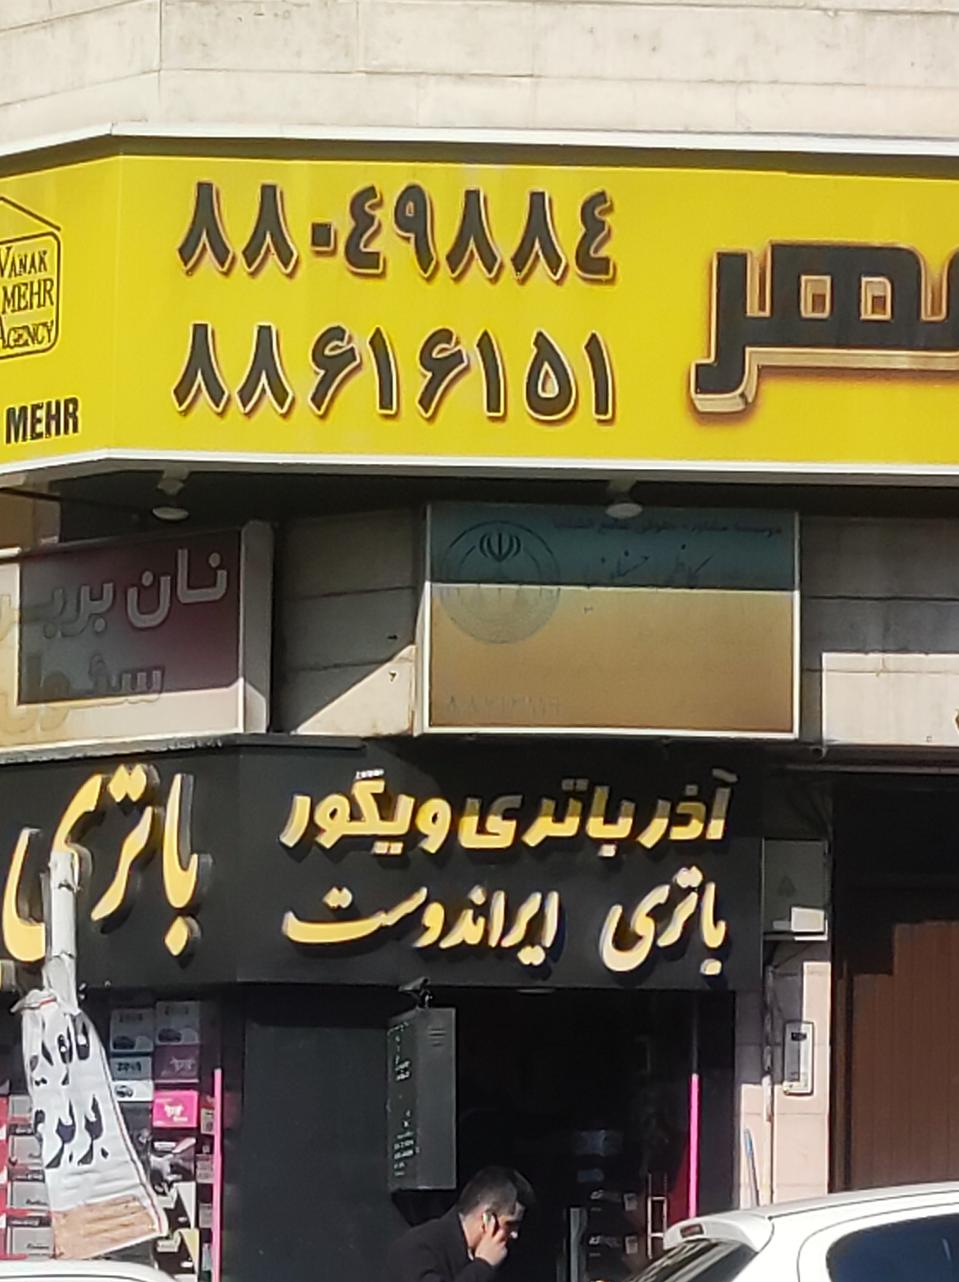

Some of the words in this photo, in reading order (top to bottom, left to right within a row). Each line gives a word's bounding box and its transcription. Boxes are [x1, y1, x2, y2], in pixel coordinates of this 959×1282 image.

[1, 277, 55, 316] MEHR
[690, 240, 959, 413] هر
[172, 322, 616, 424] ۸۸۶۱۶۱۵۱
[5, 396, 80, 446] MEHR
[126, 547, 229, 629] نان
[279, 768, 453, 855] ویگور
[458, 777, 637, 858] باتری
[637, 766, 739, 851] آذر
[282, 884, 560, 966] ایراندوست
[600, 865, 728, 976] باتری
